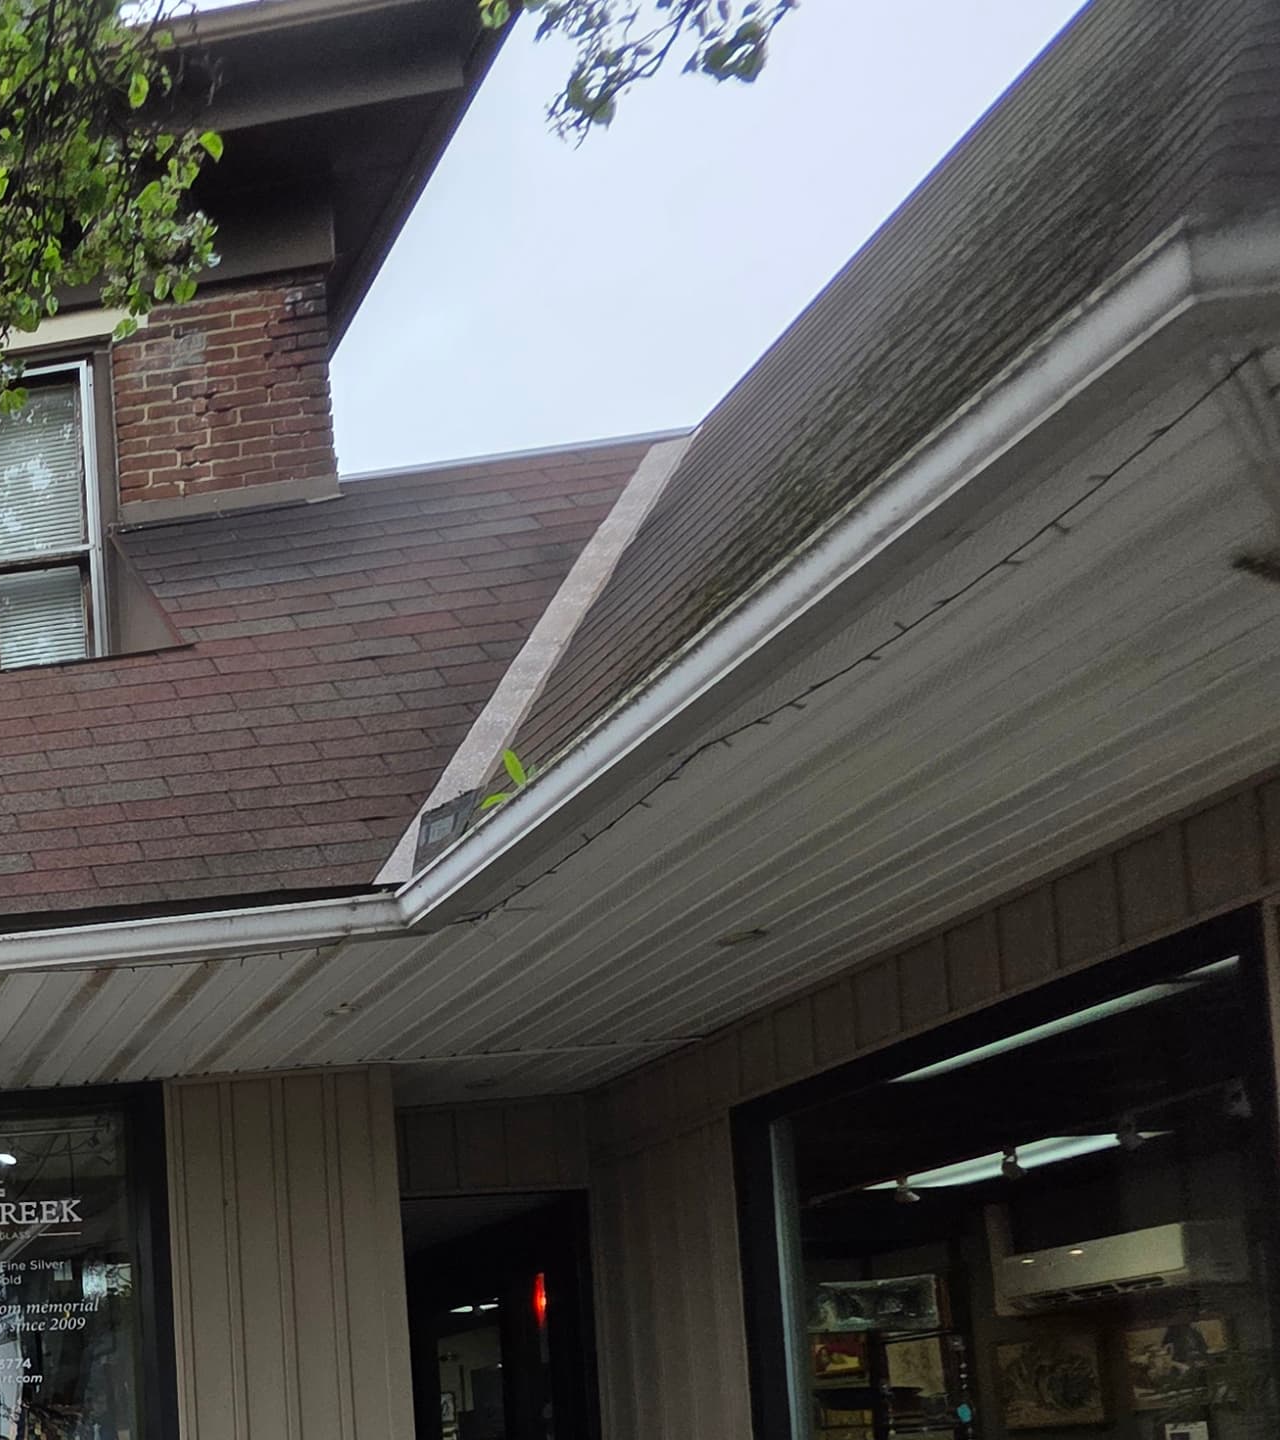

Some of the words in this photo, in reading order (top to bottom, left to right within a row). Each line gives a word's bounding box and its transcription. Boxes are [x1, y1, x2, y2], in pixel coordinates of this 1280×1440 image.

[0, 1231, 31, 1240] GLASS
[0, 1260, 26, 1271] Fine
[30, 1259, 66, 1270] Silver
[26, 1297, 99, 1314] memorial
[49, 1317, 86, 1331] 2009
